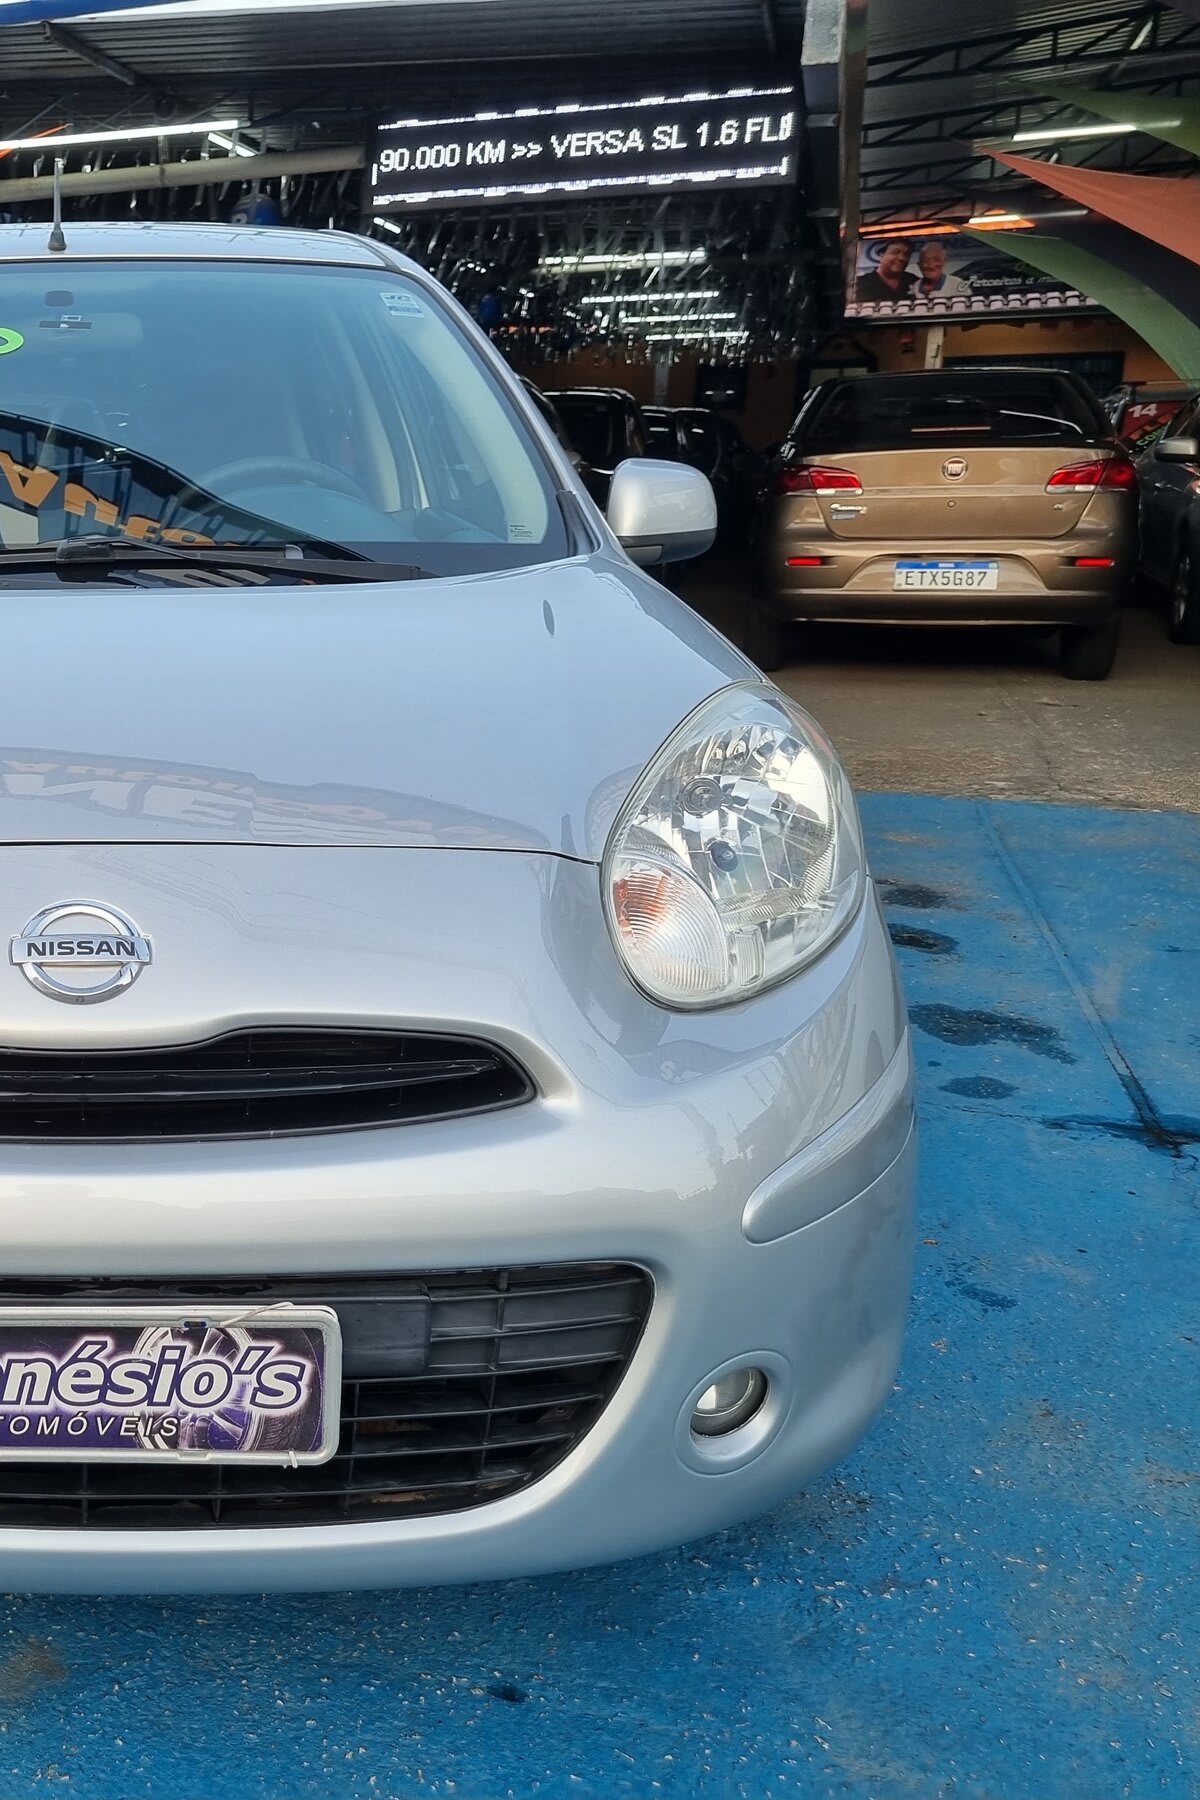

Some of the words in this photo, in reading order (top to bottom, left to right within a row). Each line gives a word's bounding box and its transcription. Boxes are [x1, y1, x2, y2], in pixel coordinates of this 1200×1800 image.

[380, 143, 460, 172] 90.000
[466, 140, 506, 165] KM
[550, 127, 645, 159] VERSA
[652, 124, 688, 151] SL
[696, 118, 740, 147] 1.6
[1128, 403, 1158, 418] 14
[904, 570, 988, 586] ETX5G87
[26, 940, 136, 957] NISSAN
